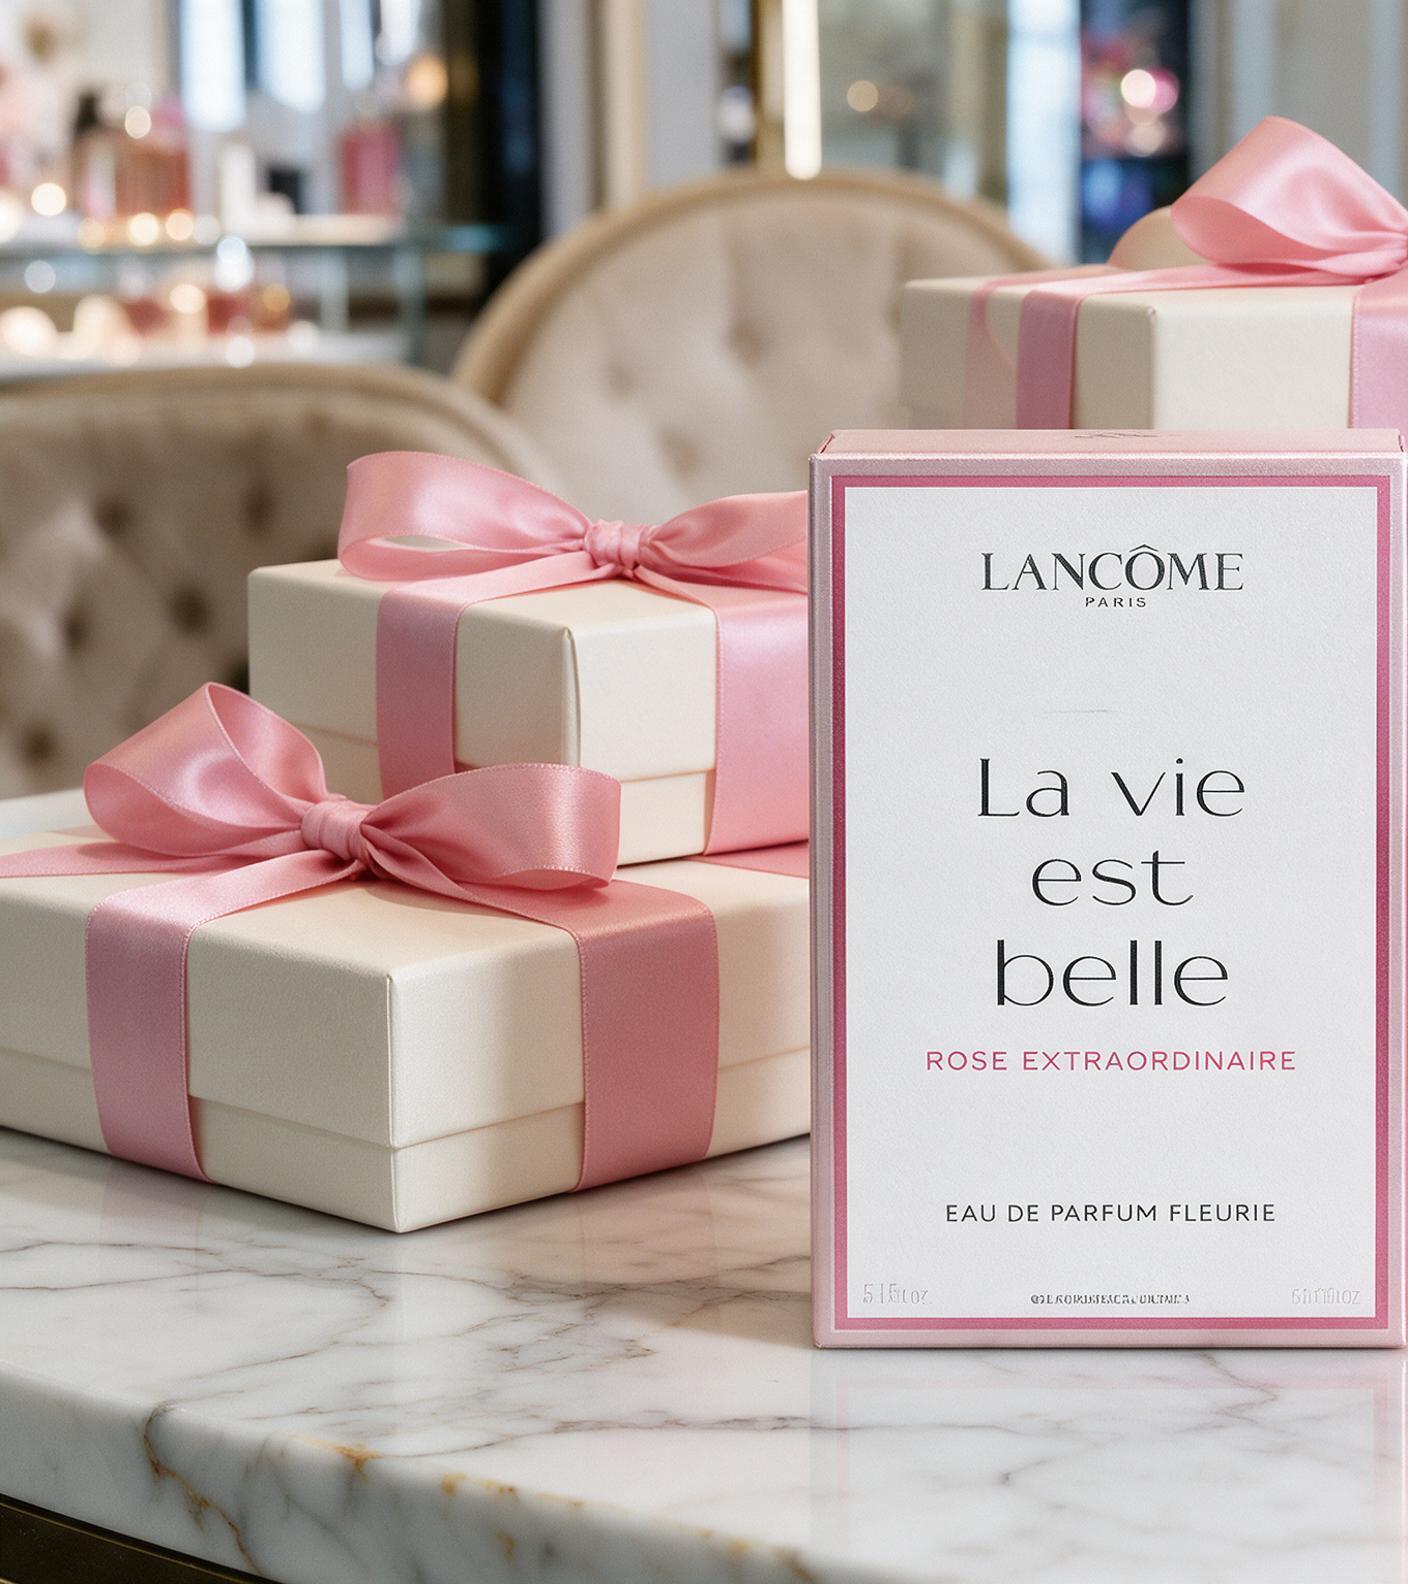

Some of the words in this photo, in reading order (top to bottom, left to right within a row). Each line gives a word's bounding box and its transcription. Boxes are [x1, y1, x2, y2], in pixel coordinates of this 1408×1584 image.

[980, 543, 1244, 591] LANCÔME
[1085, 596, 1147, 608] PARIS
[977, 757, 1070, 818] La
[1110, 757, 1246, 818] vie
[1031, 849, 1194, 907] est
[996, 938, 1229, 1007] belle
[926, 1050, 1008, 1072] ROSE
[1023, 1050, 1296, 1072] EXTRAORDINAIRE
[945, 1203, 996, 1223] EAU
[1007, 1203, 1039, 1223] DE
[1051, 1203, 1157, 1223] PARFUM
[1169, 1203, 1276, 1223] FLEURIE
